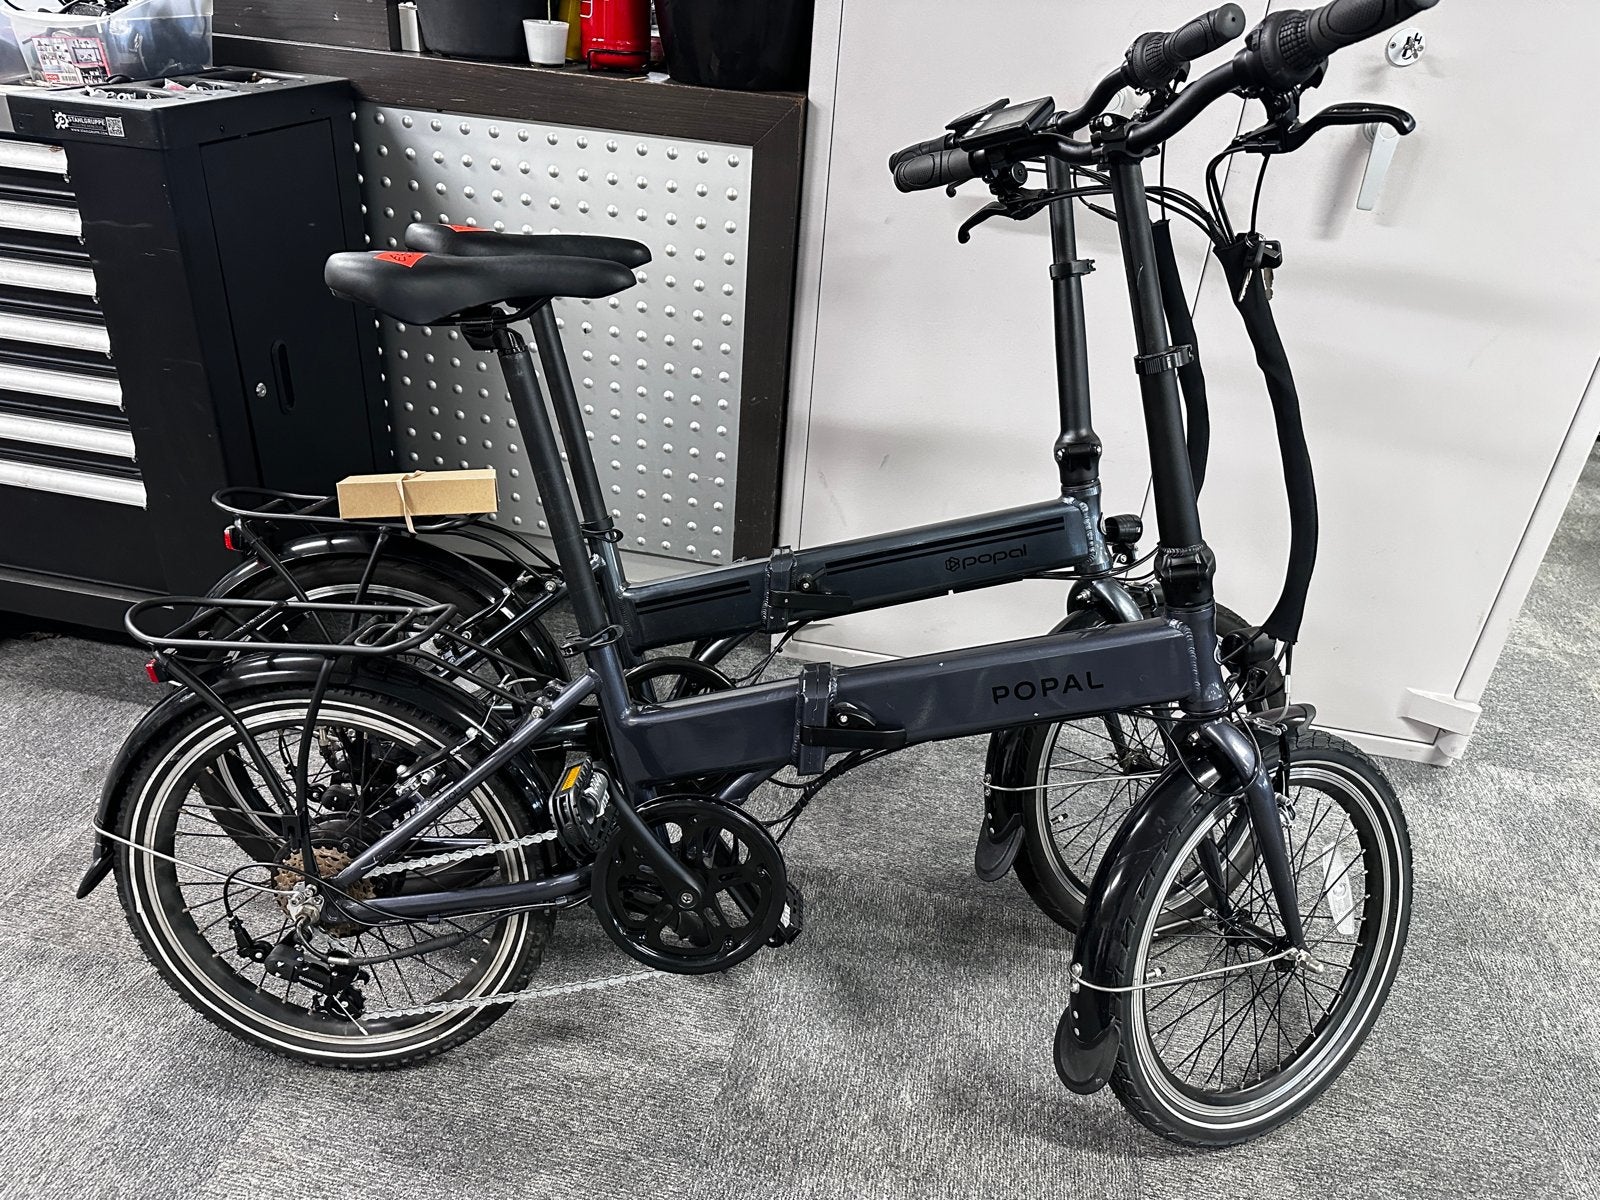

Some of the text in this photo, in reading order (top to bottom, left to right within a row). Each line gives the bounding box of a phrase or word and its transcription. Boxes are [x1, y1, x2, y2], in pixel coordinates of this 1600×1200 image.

[68, 116, 106, 126] STAHLGRUPPE
[962, 544, 1027, 570] popal
[992, 671, 1104, 705] POPAL
